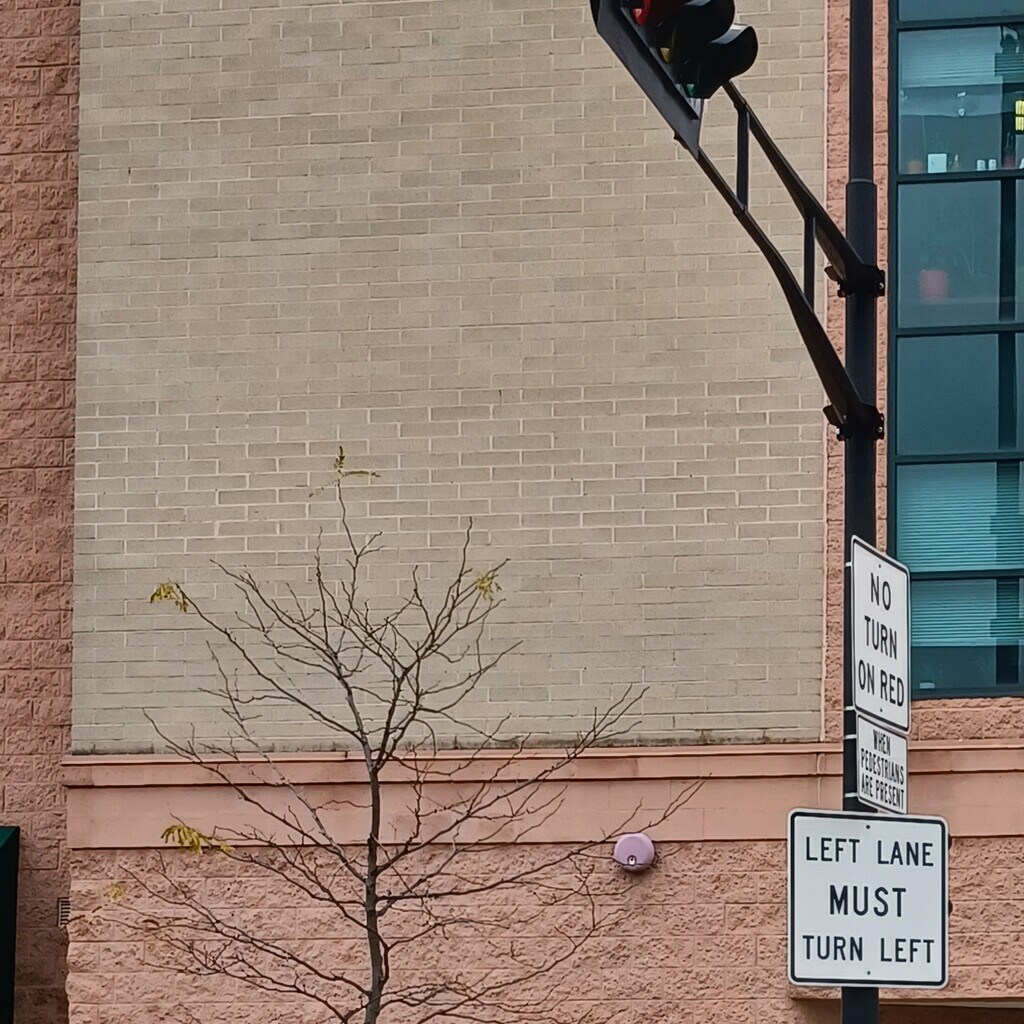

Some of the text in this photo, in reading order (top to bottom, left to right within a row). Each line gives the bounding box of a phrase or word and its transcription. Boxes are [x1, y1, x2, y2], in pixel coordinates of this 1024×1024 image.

[870, 572, 892, 611] NO
[864, 616, 898, 660] TURN
[858, 659, 905, 708] ON RED
[873, 729, 891, 756] WHEN
[861, 748, 904, 785] PEDESTRIANS
[861, 773, 905, 810] ARE PRESENT
[805, 837, 934, 867] LEFT LANE
[829, 885, 906, 918] MUST
[803, 935, 935, 964] TURN LEFT
